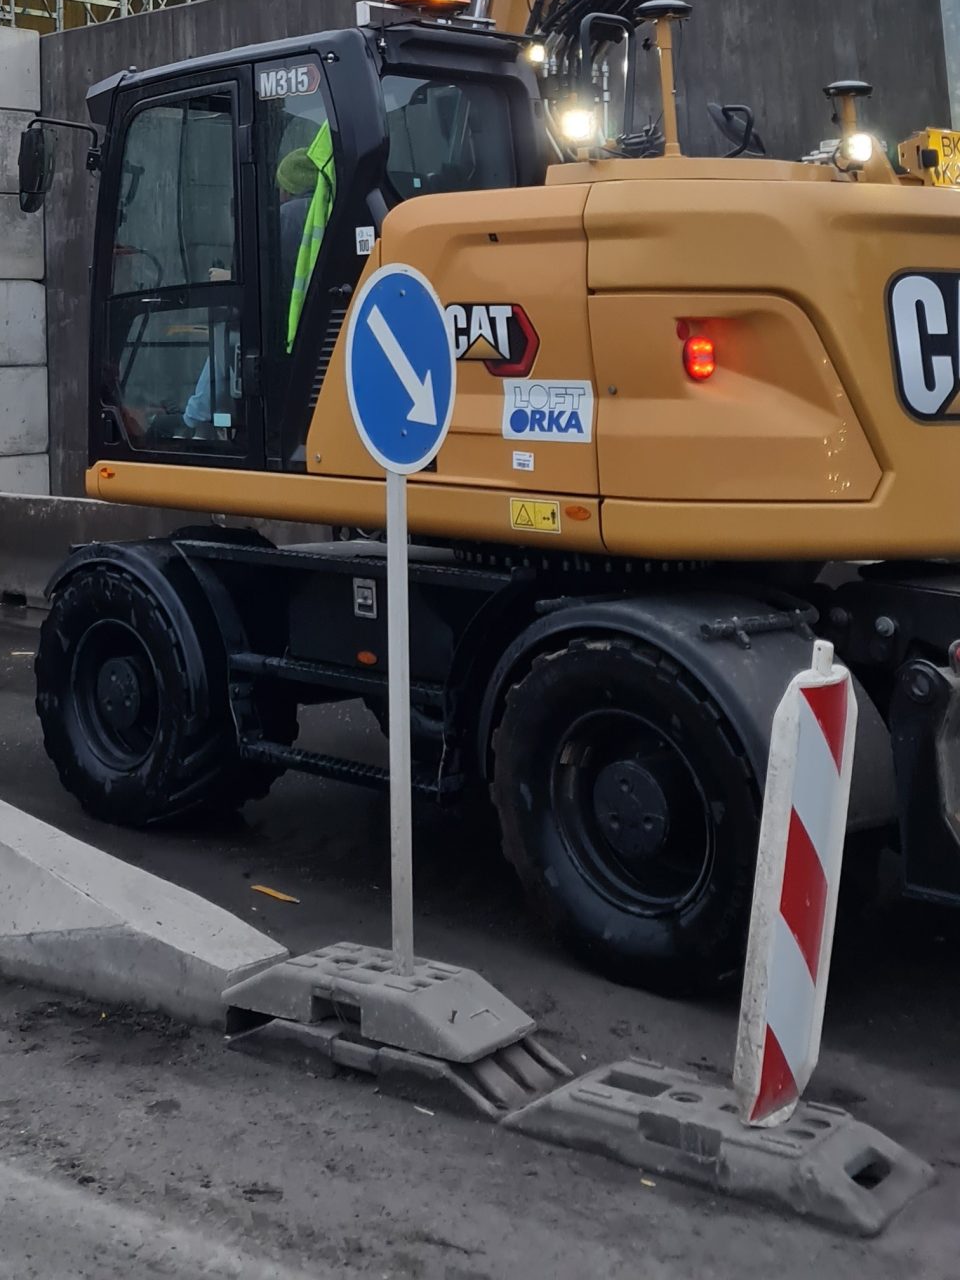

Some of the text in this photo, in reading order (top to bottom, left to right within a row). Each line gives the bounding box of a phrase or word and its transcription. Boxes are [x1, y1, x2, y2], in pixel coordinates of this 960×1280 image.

[260, 66, 309, 98] M315
[445, 305, 512, 360] CAT
[513, 384, 586, 410] LOFT
[509, 408, 585, 434] ORKA
